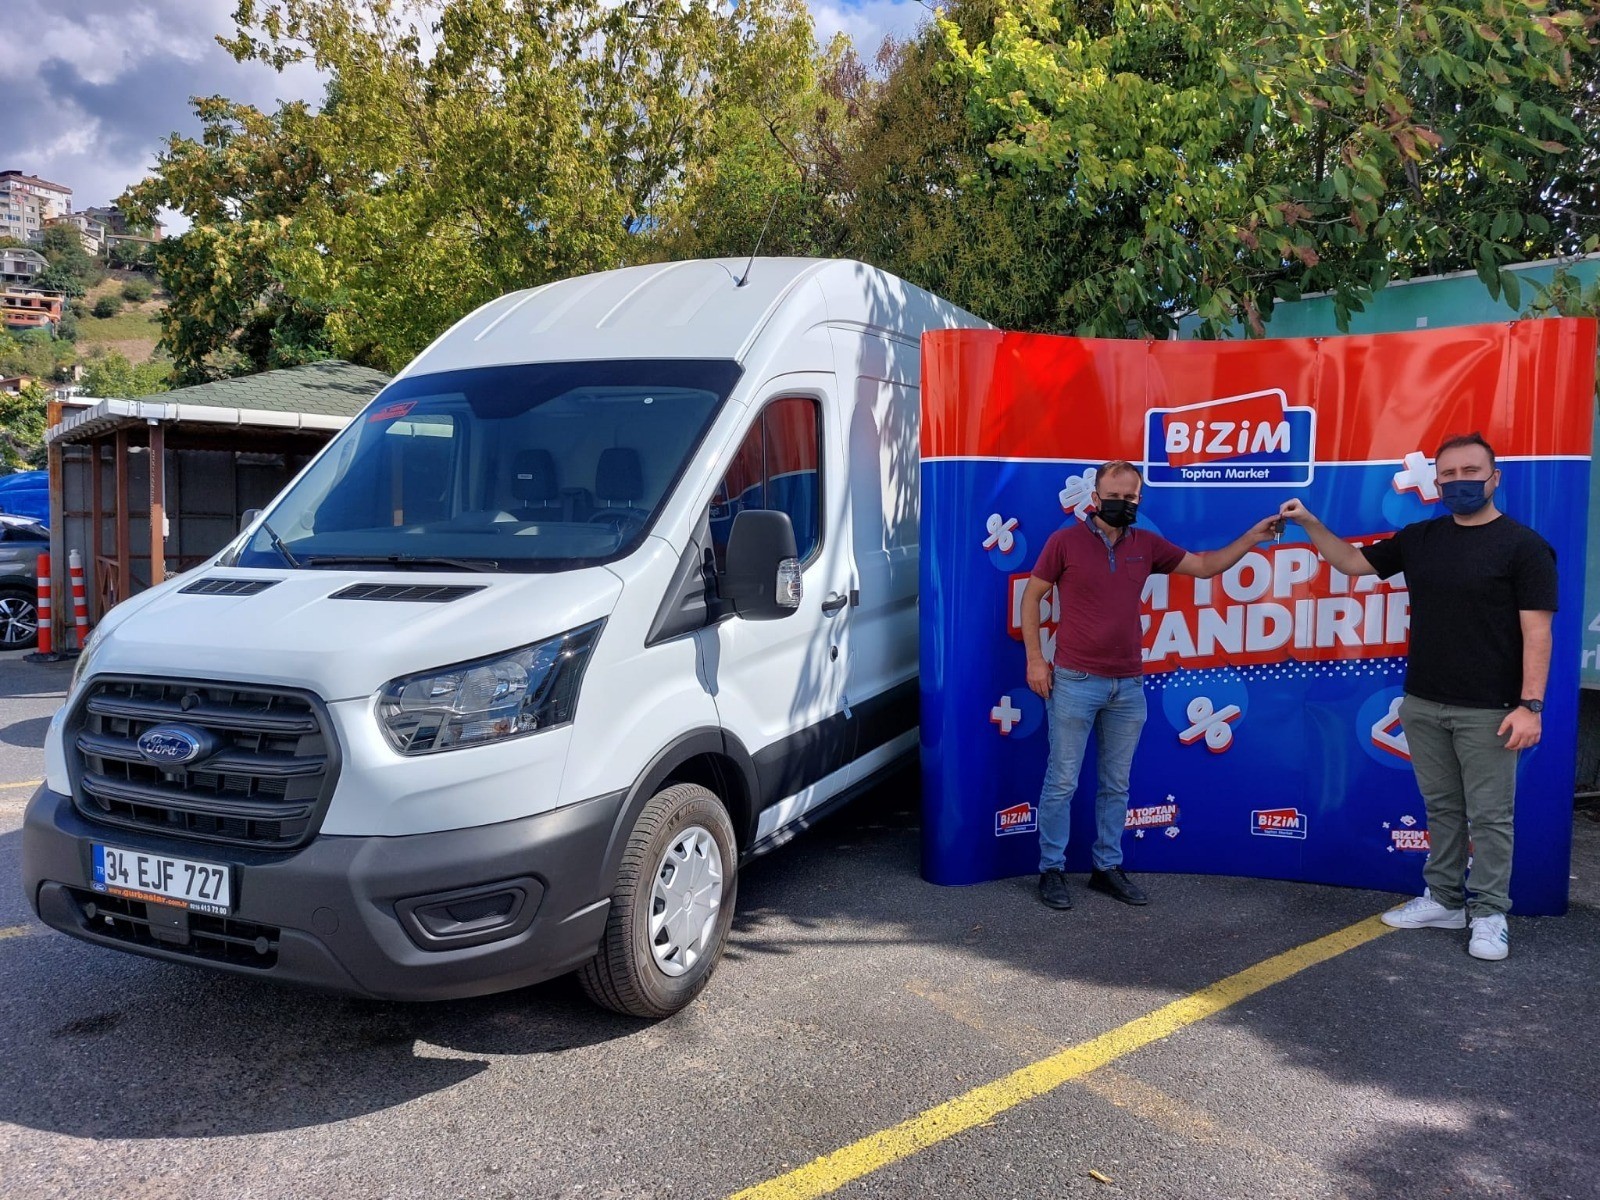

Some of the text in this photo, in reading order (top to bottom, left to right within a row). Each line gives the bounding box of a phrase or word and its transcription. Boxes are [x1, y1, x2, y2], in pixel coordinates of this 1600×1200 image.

[1180, 468, 1270, 481] Toptan Market
[146, 734, 180, 756] Ford
[1136, 805, 1176, 818] TOPTAN
[1125, 814, 1172, 827] ZANDIRIR
[1392, 830, 1425, 840] BIZIM
[96, 865, 105, 876] TR
[106, 851, 224, 900] 34 EJF 727
